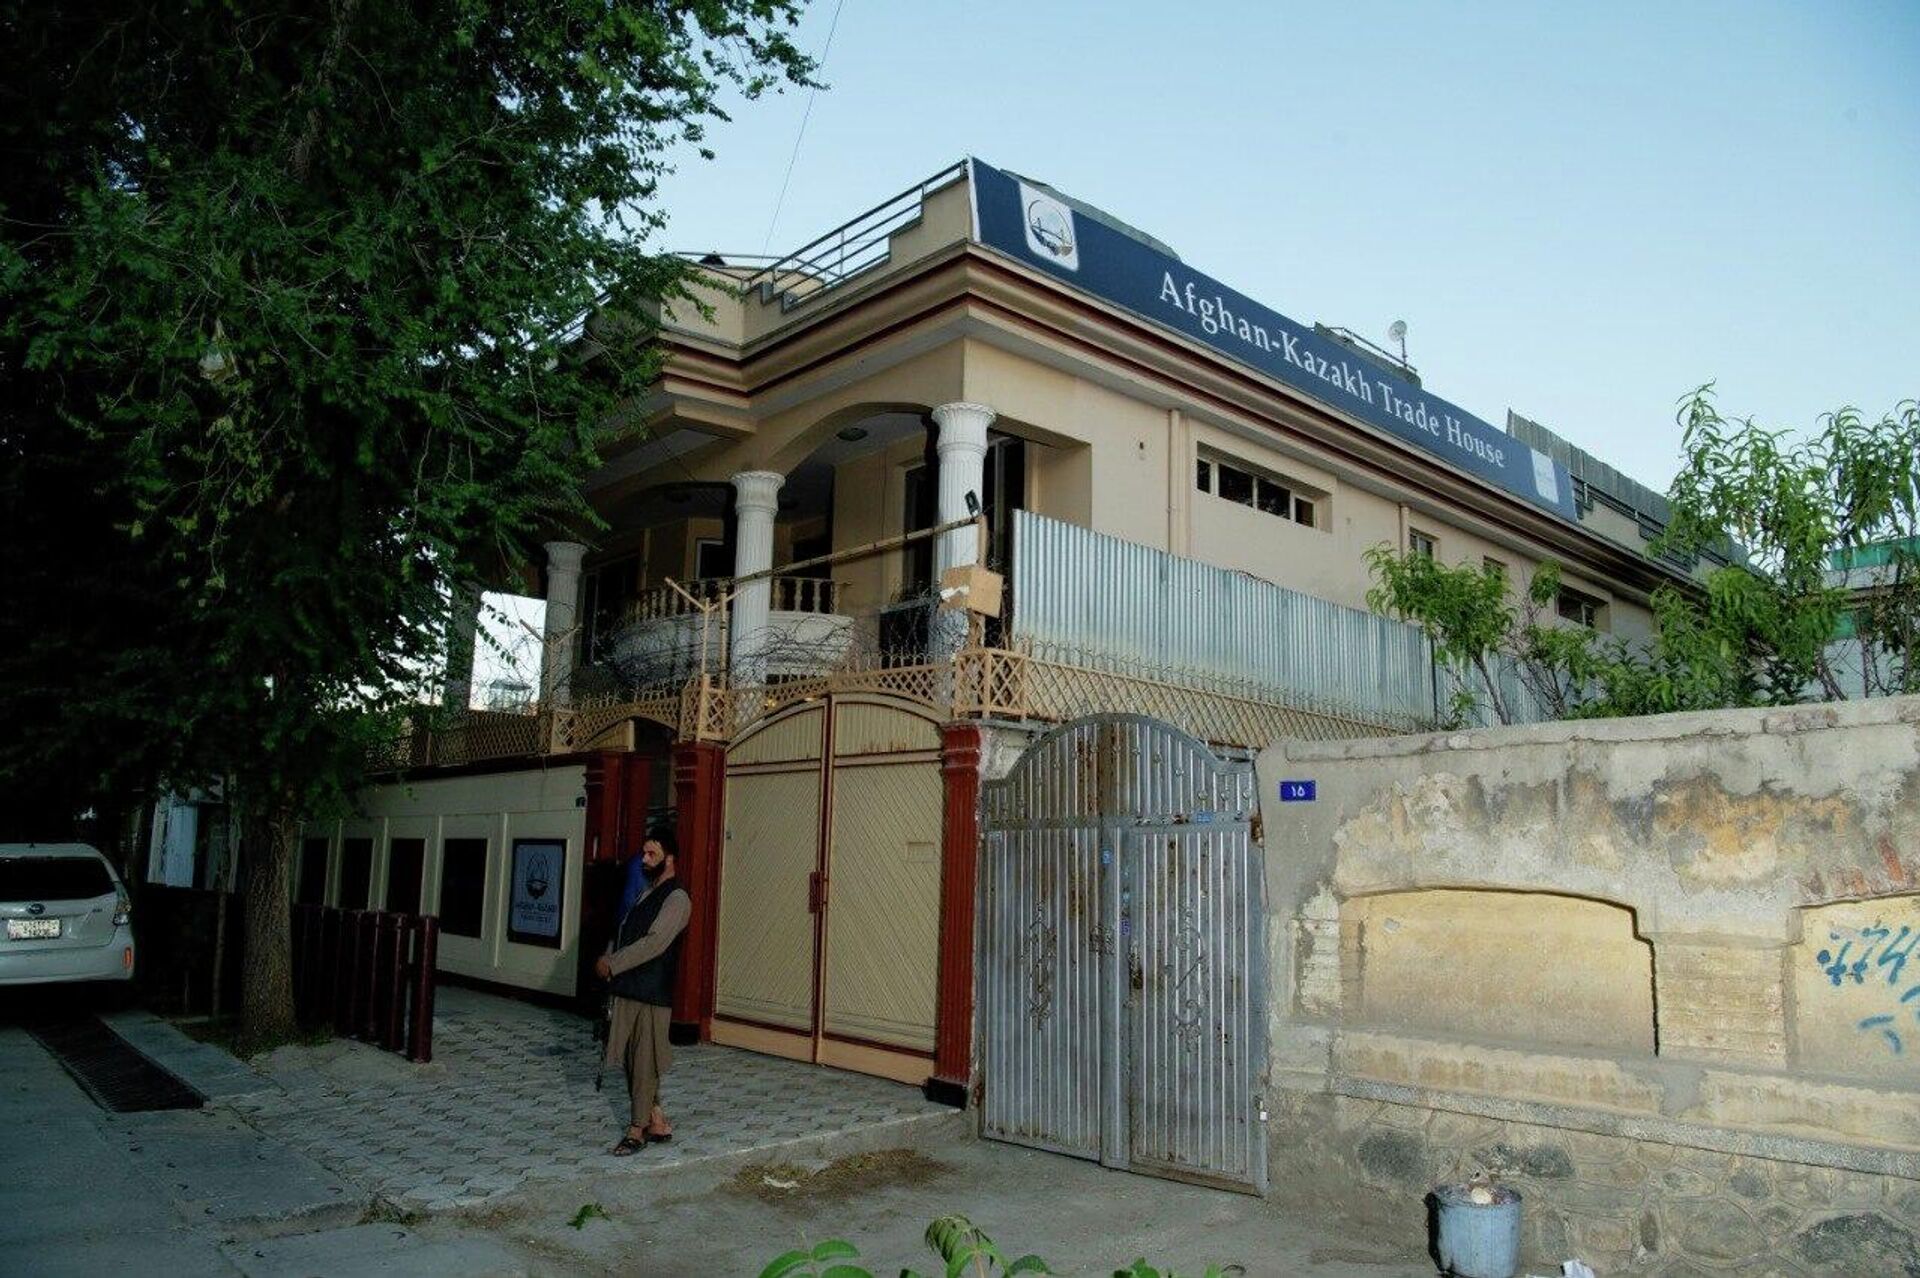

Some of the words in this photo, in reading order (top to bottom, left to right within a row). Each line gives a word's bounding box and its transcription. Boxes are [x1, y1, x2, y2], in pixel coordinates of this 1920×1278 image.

[1159, 270, 1373, 404] Afghan-Kazakh
[1377, 380, 1440, 437] Trade
[1444, 413, 1505, 468] House
